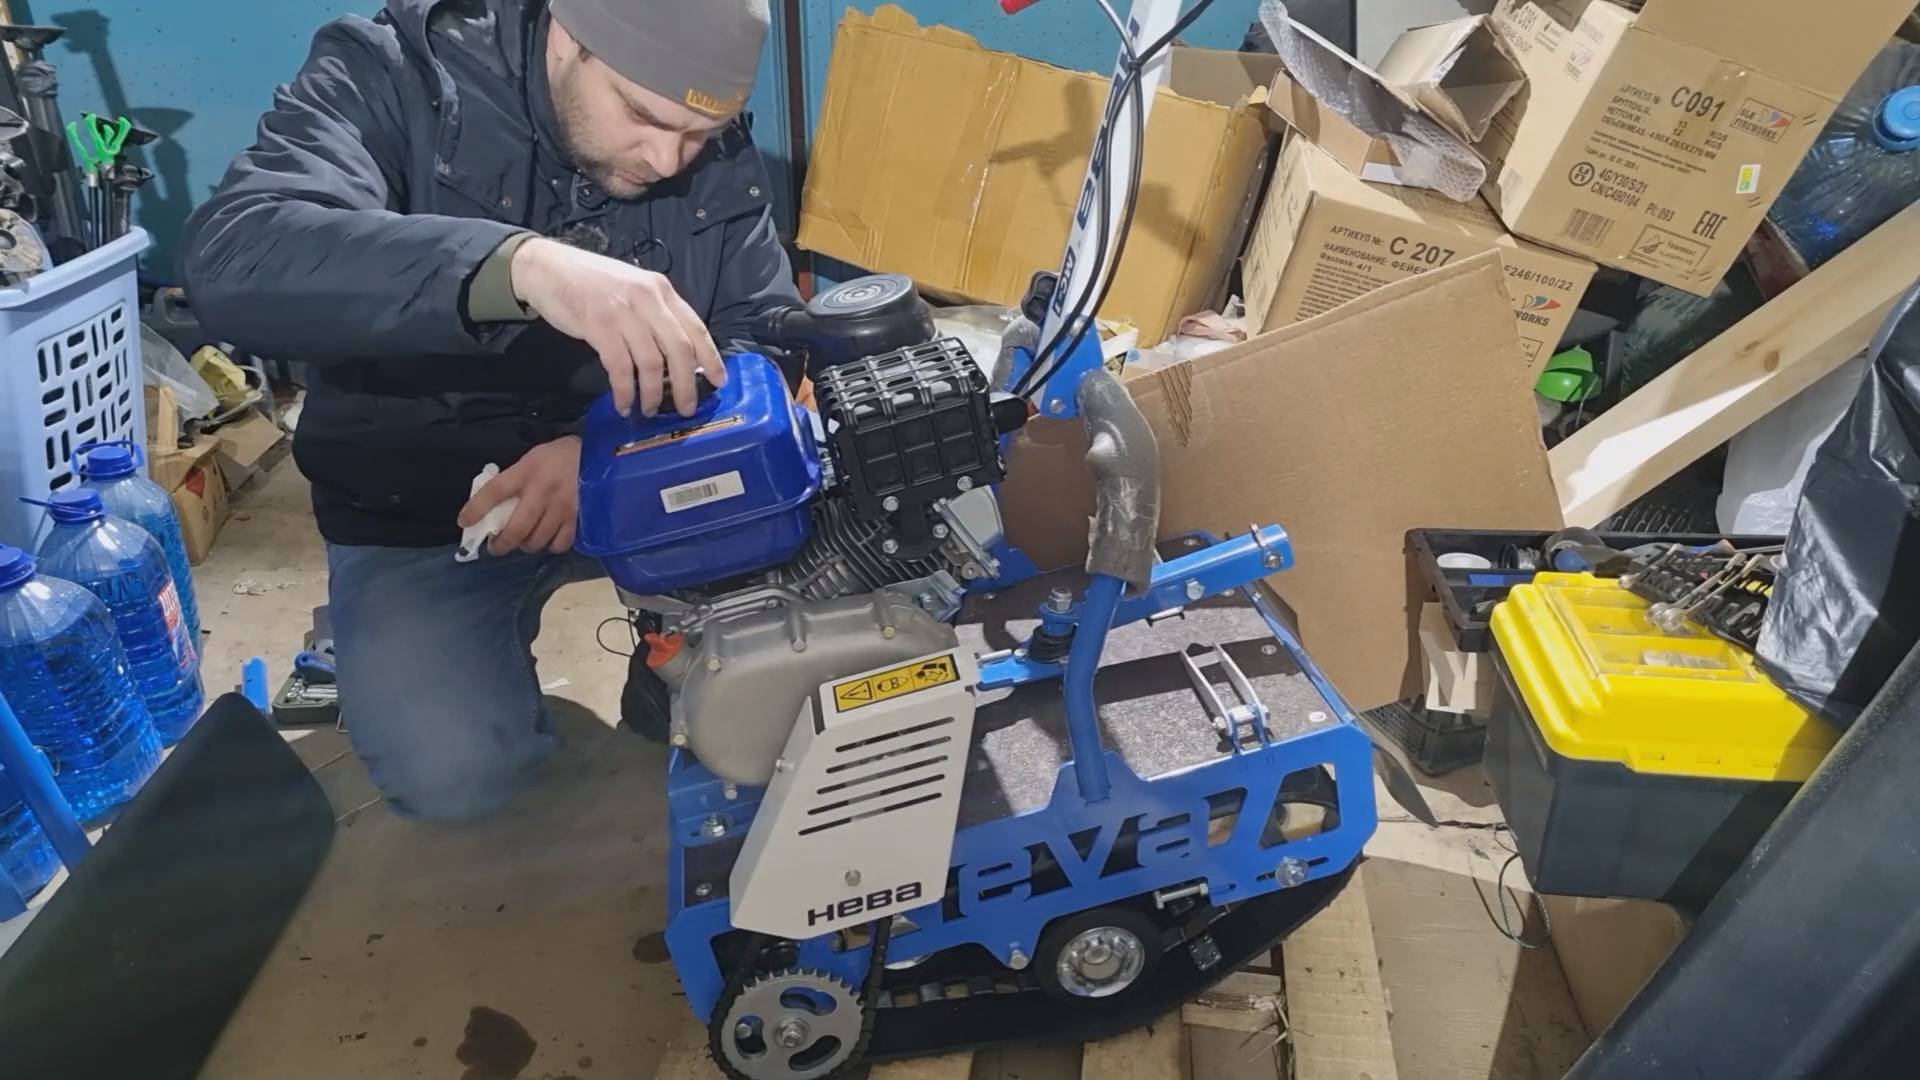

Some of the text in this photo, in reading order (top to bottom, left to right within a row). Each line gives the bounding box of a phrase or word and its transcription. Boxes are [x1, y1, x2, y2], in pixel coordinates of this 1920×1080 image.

[1671, 86, 1726, 122] C091
[1709, 130, 1728, 143] KGS
[1704, 138, 1723, 151] KGS
[1330, 225, 1371, 241] АРТИКУЛ
[1410, 242, 1455, 267] 207
[1356, 263, 1372, 273] 4/1
